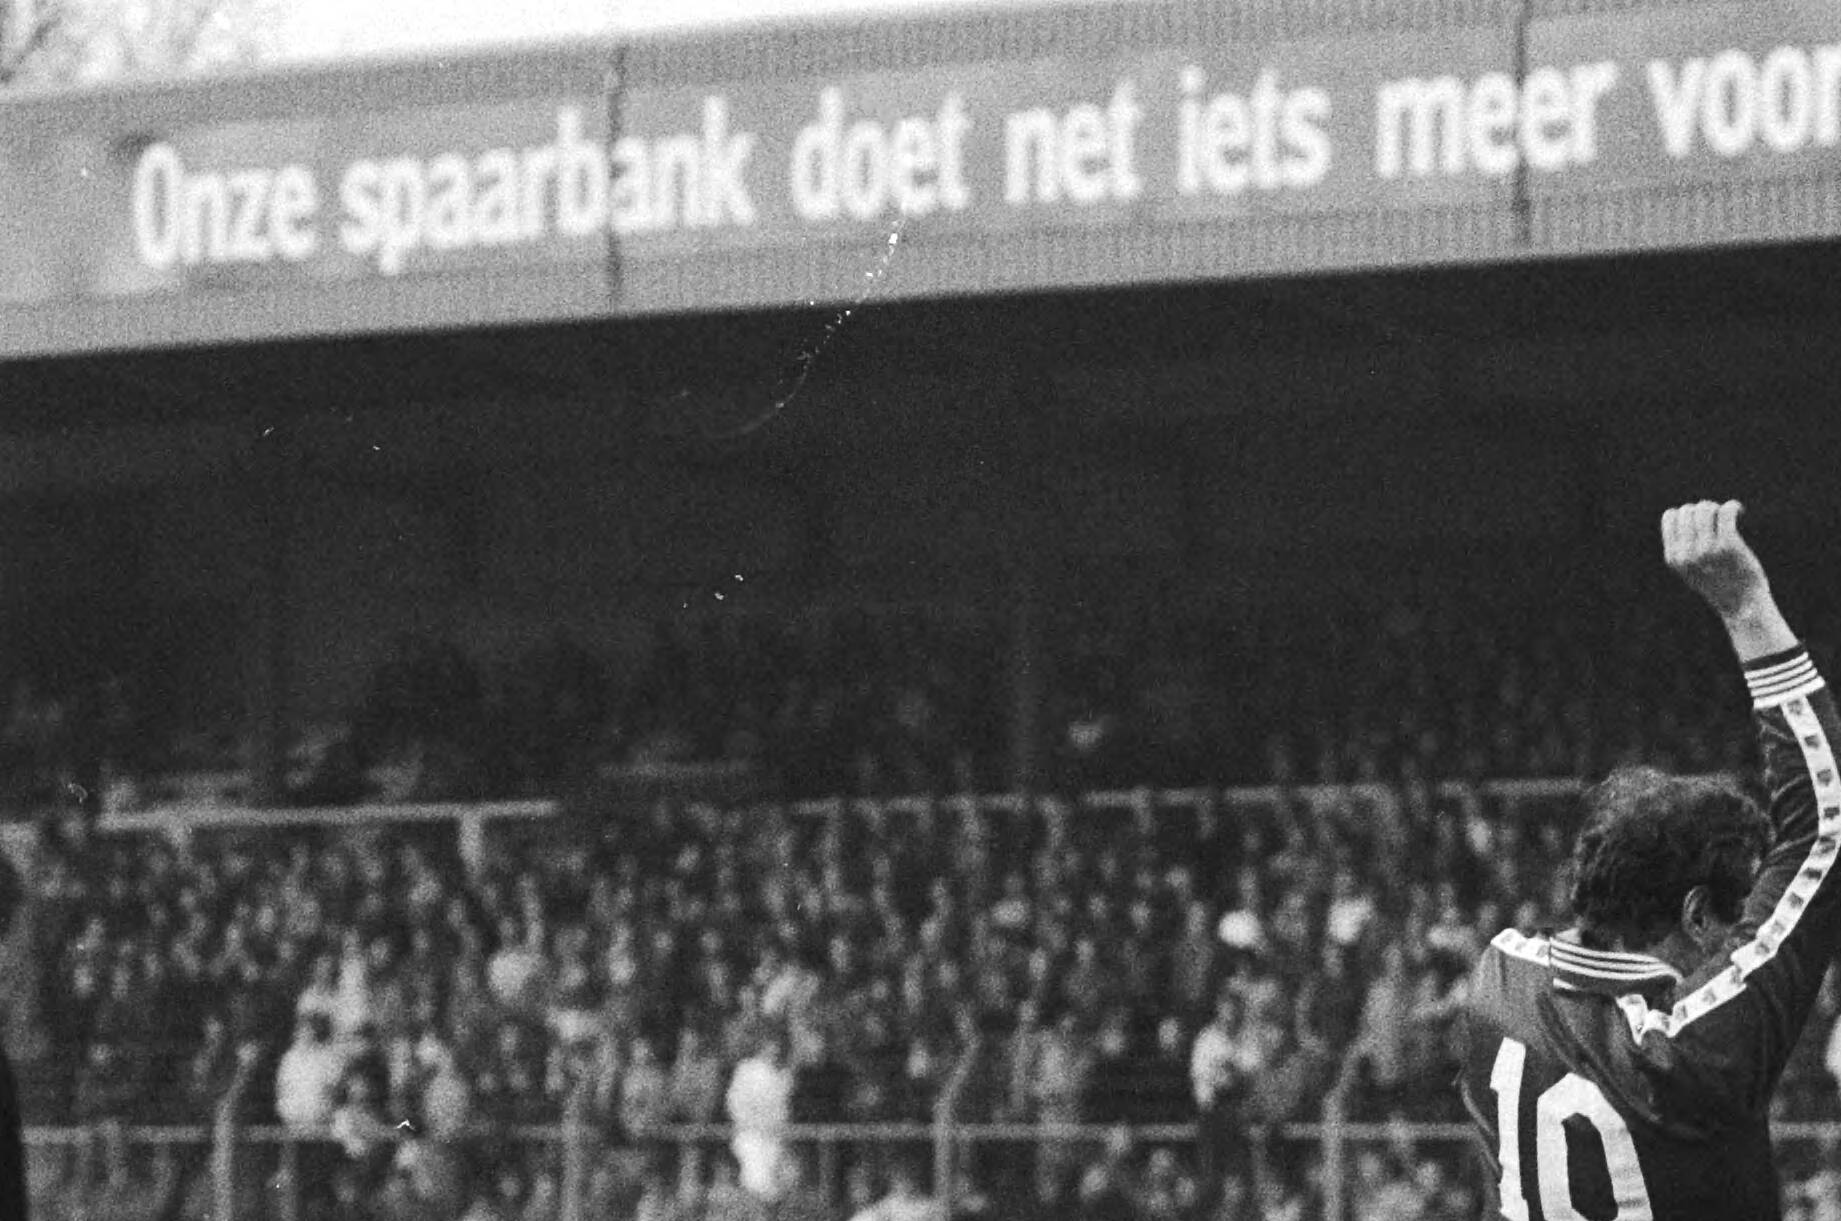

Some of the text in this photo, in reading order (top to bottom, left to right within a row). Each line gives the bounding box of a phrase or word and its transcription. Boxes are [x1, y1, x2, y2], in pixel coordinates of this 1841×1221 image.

[133, 140, 320, 269] Onze
[339, 95, 758, 276] spaarbank
[790, 86, 972, 223] doet
[1003, 79, 1142, 202] net
[1176, 64, 1334, 198] iets
[1374, 60, 1618, 179] meer
